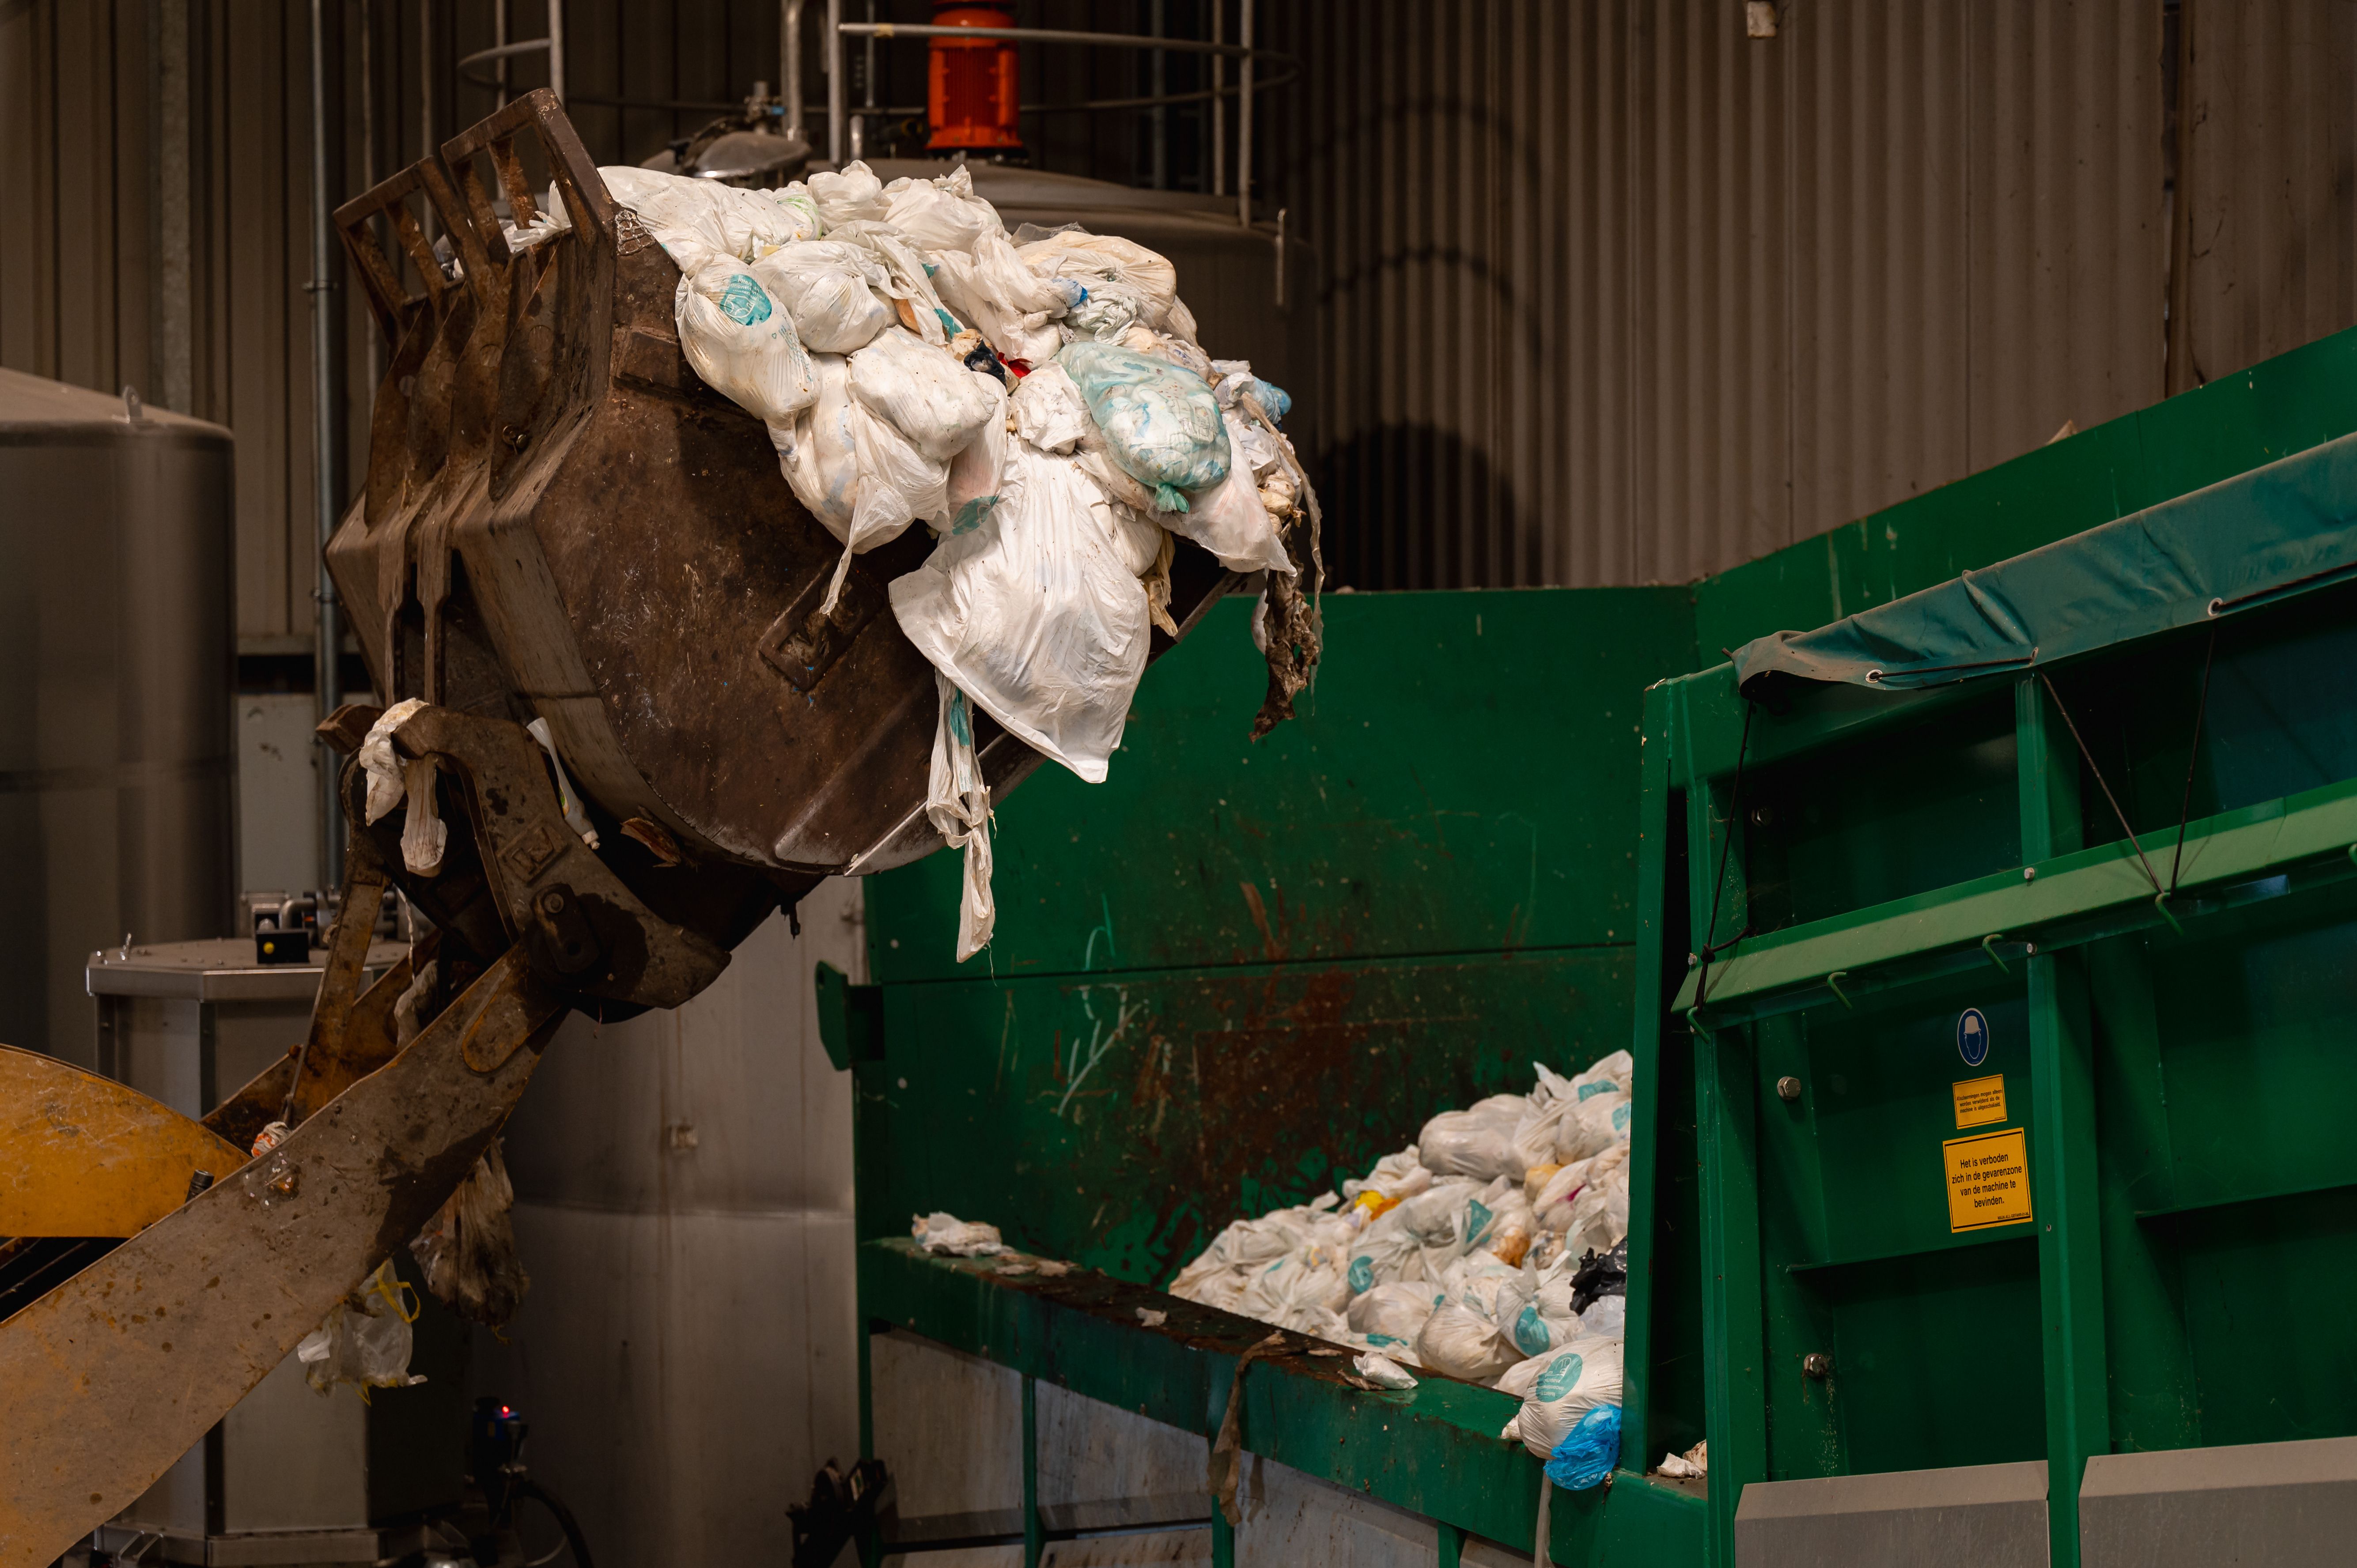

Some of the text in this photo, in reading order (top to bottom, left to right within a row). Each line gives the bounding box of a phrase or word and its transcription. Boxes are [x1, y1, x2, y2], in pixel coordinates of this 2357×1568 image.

[1960, 1153, 2009, 1169] Het is verboden
[1952, 1165, 2022, 1184] zich in de gevarenzone
[1960, 1179, 2016, 1196] van de machine te
[1974, 1196, 2005, 1208] bevinden.
